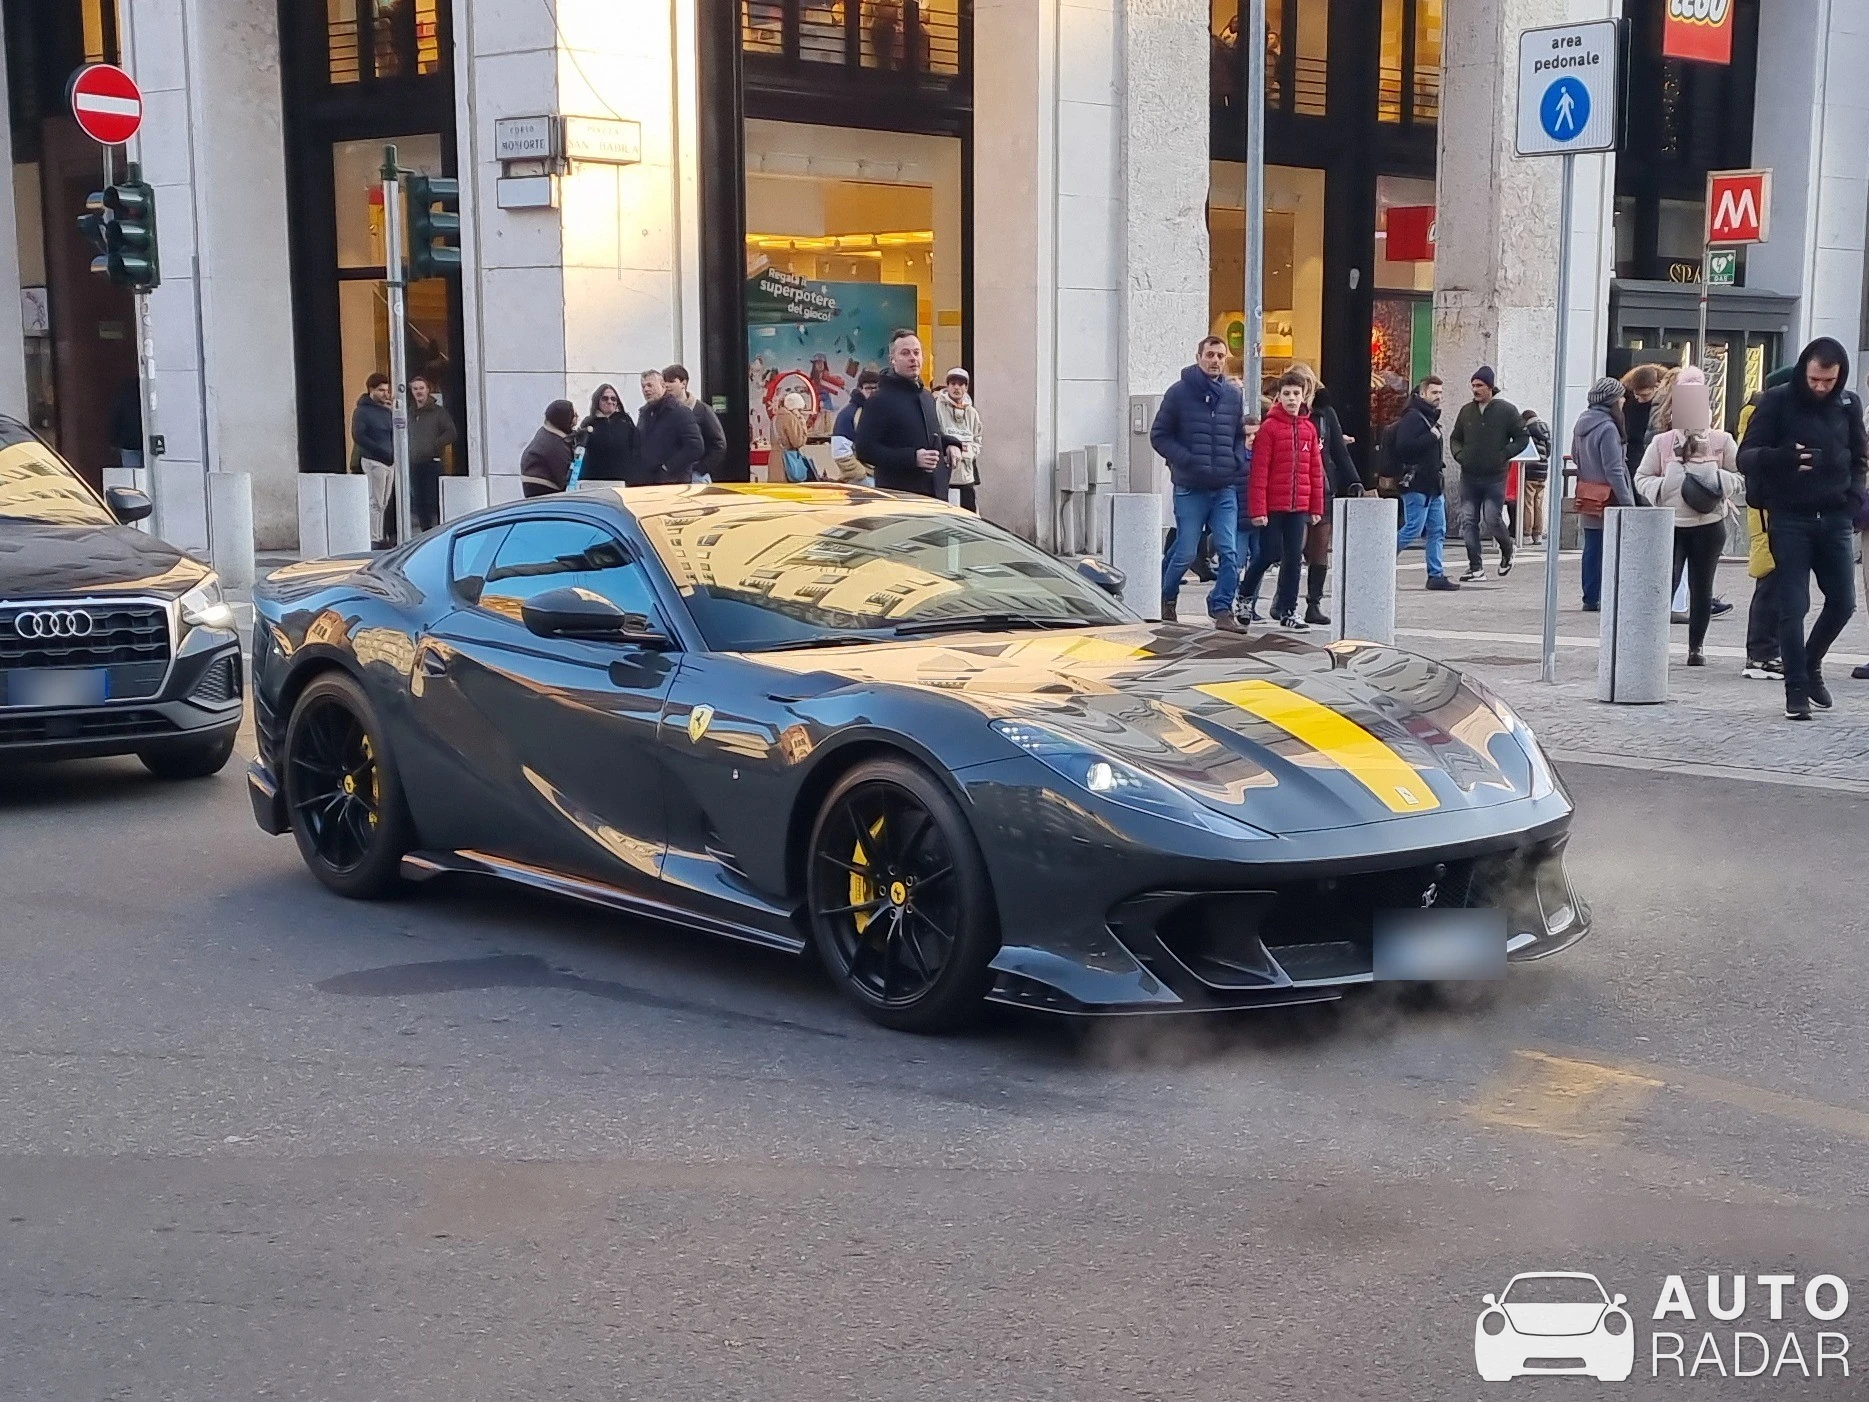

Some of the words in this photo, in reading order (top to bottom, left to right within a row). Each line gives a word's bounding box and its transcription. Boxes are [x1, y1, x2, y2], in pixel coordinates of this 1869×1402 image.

[1551, 35, 1582, 49] area
[1534, 51, 1600, 73] pedonale
[568, 139, 589, 149] SAN
[1713, 188, 1759, 230] M
[768, 267, 799, 285] Regala
[759, 279, 836, 309] superpotere
[787, 302, 802, 314] del
[803, 307, 831, 322] gioco!
